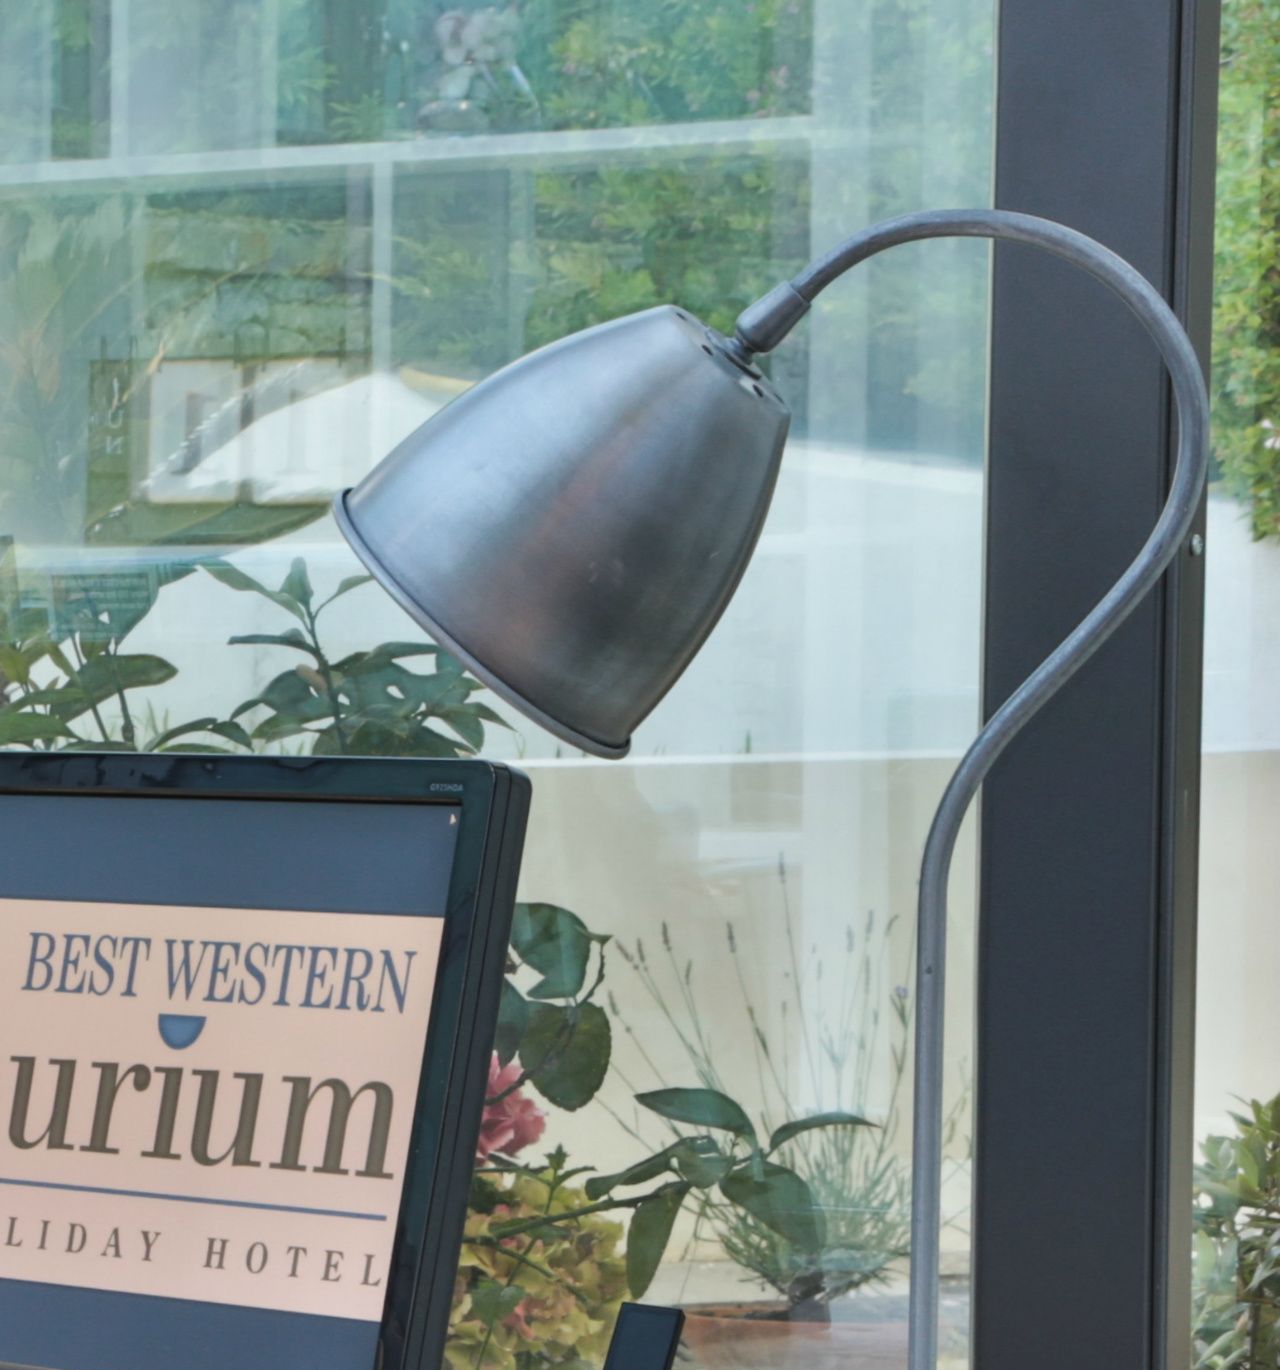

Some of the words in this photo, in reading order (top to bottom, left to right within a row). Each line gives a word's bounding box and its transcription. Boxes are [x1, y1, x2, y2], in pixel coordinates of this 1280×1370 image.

[21, 931, 153, 998] BEST
[164, 938, 417, 1015] WESTERN
[203, 1236, 382, 1288] HOTEL
